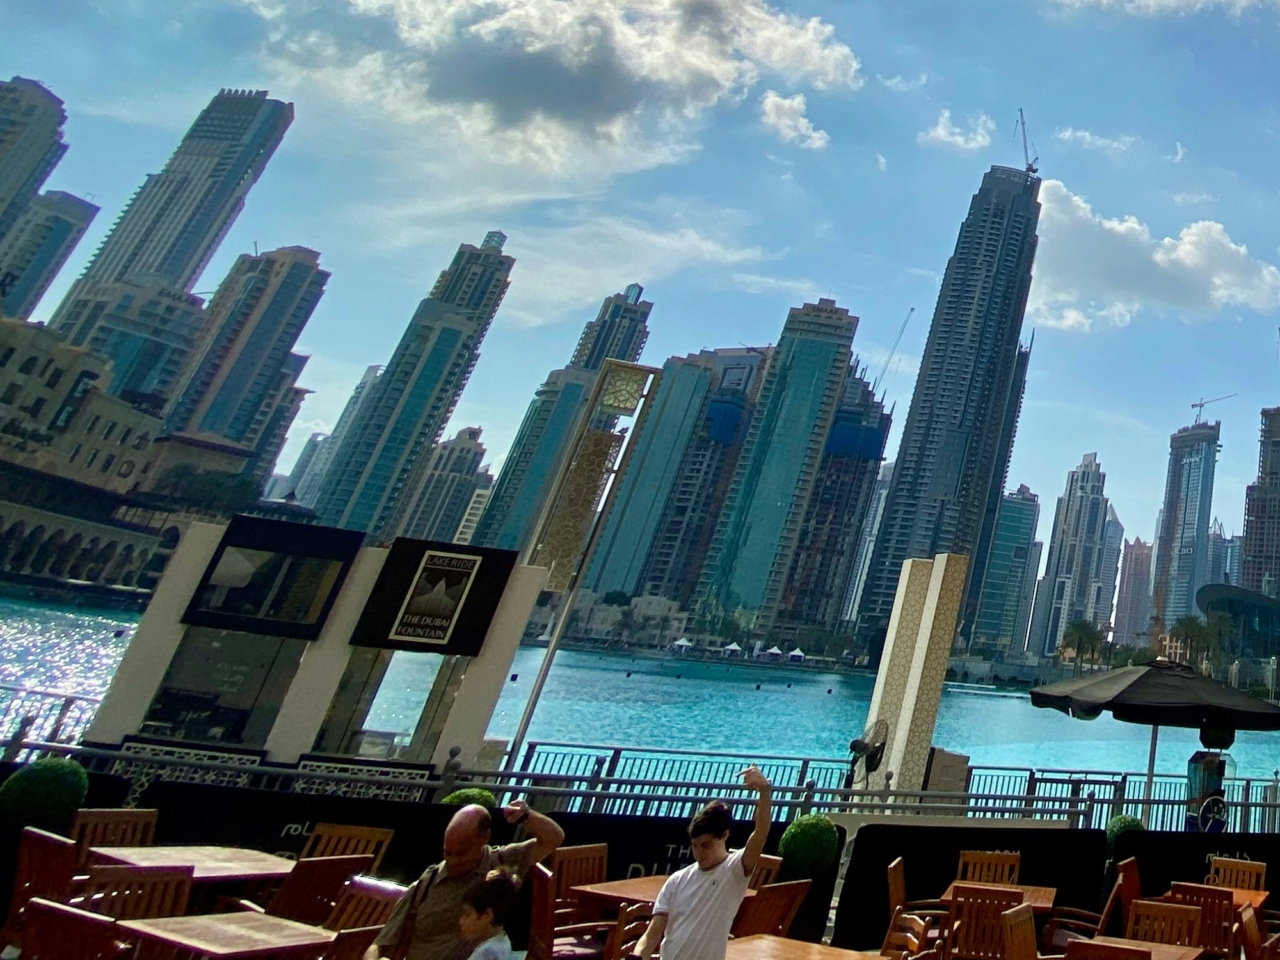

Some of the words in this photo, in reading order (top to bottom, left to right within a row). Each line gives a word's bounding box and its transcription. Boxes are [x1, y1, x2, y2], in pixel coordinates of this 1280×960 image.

[426, 555, 450, 567] LAKE
[450, 559, 475, 570] RIDE
[402, 614, 420, 625] THE
[420, 616, 451, 628] DUBAI
[396, 626, 447, 638] FOUNTAIN
[666, 844, 692, 859] TH
